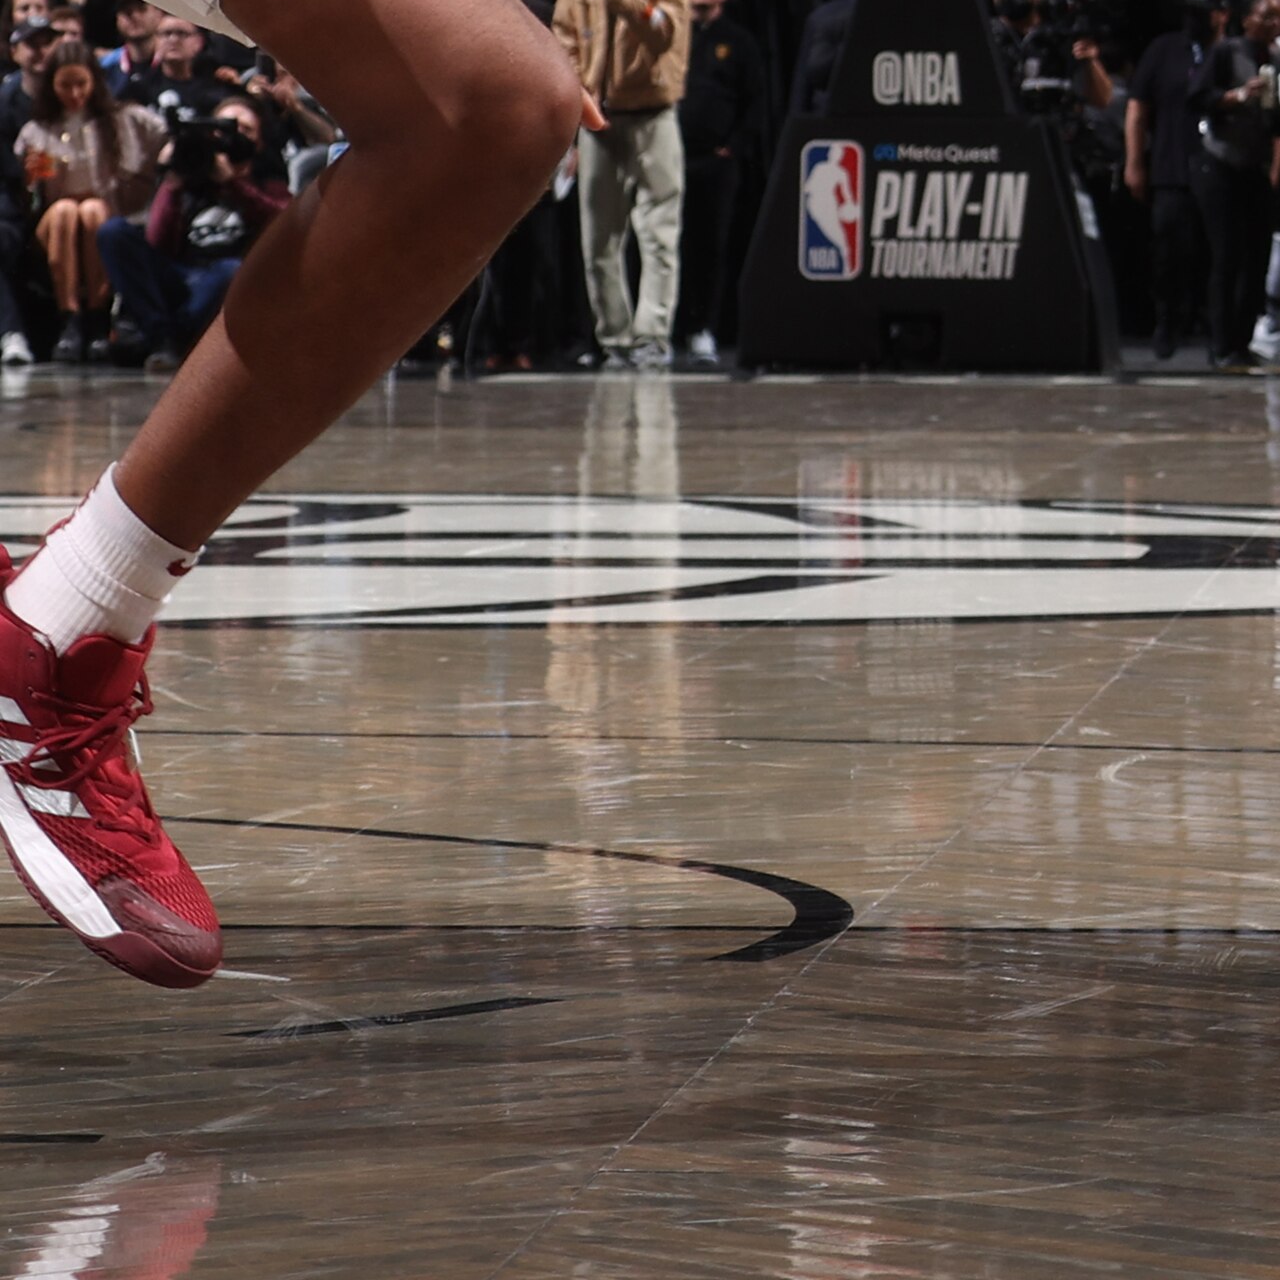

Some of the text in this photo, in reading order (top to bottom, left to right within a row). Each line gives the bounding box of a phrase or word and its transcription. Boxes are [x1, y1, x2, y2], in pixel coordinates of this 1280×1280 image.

[872, 51, 962, 106] @NBA
[898, 143, 1000, 163] Meta Quest
[870, 171, 1029, 238] PLAY-IN
[808, 246, 839, 270] NBA
[870, 240, 1020, 280] TOURNAMENT
